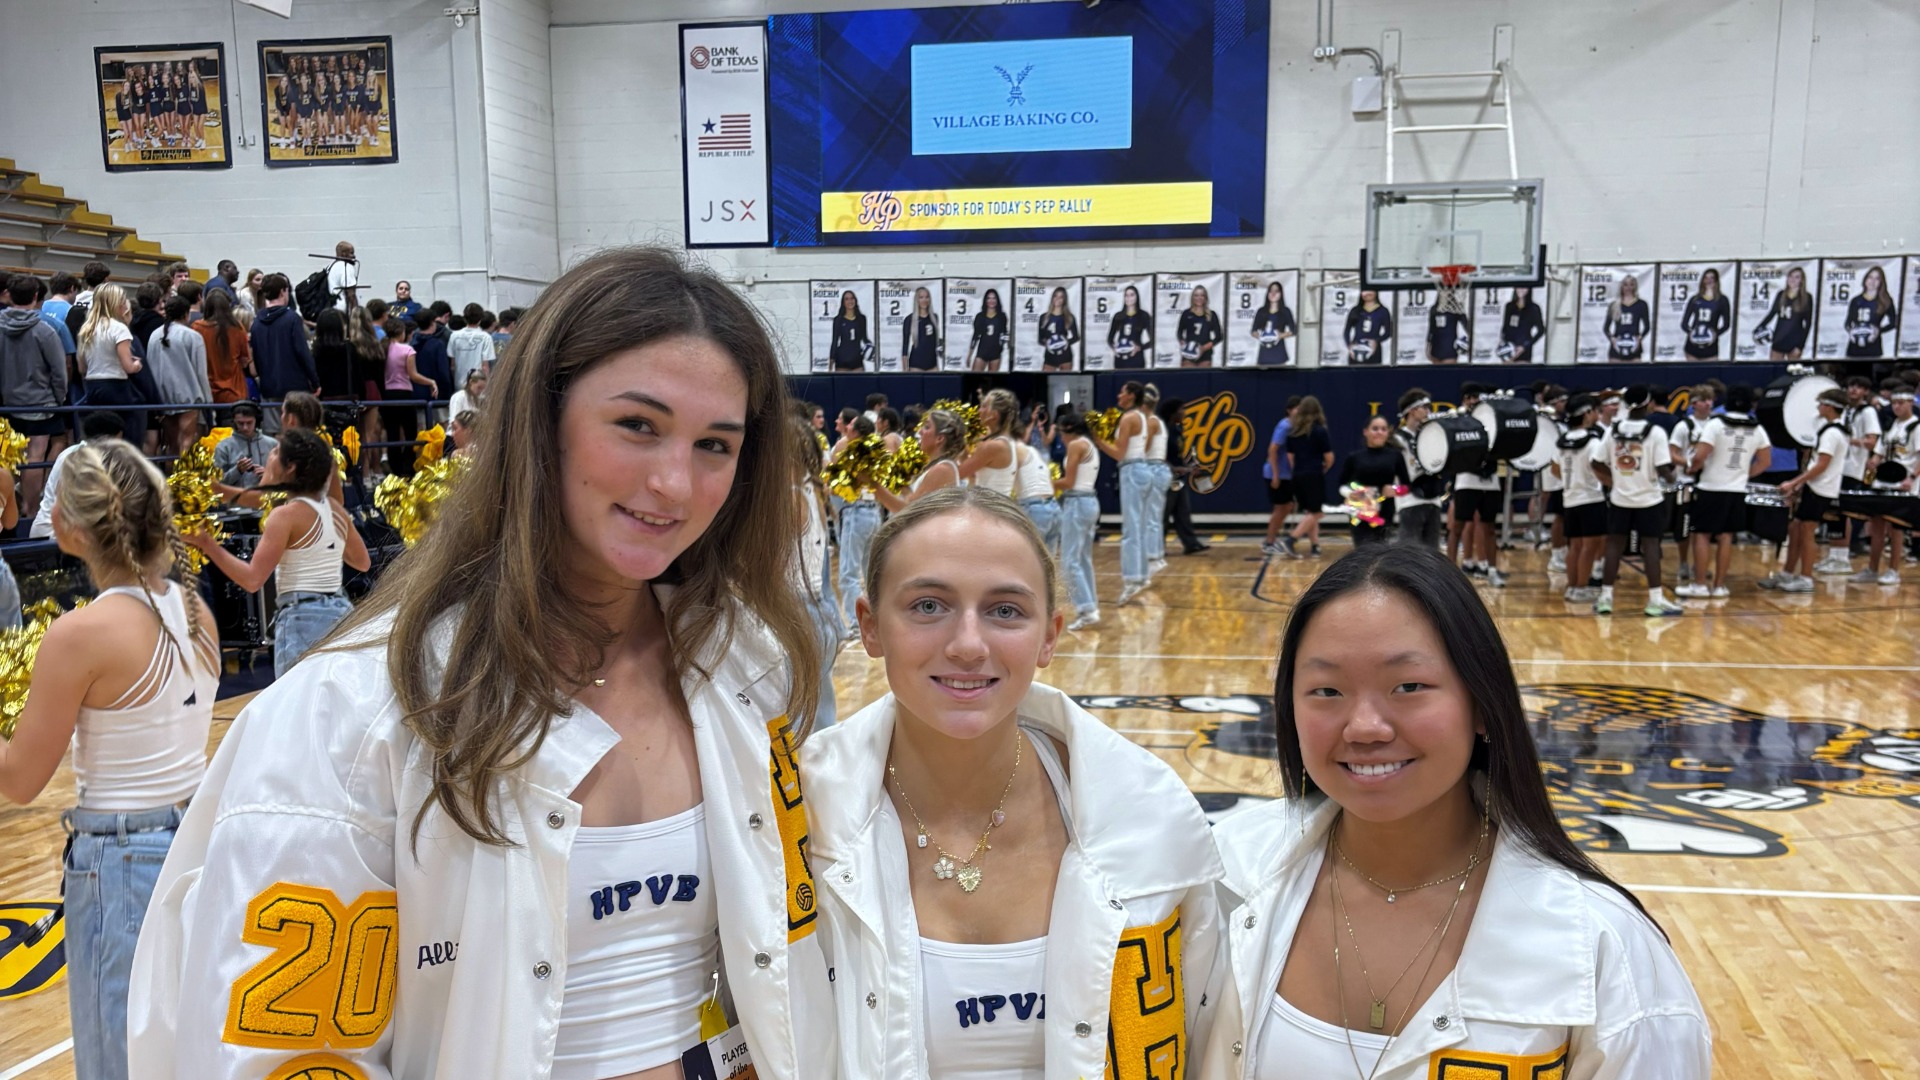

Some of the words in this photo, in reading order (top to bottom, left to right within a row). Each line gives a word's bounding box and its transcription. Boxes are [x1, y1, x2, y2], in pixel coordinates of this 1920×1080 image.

[711, 46, 739, 57] BANK
[711, 57, 724, 67] OF
[726, 56, 759, 66] TEXAS
[933, 114, 1001, 129] VILLAGE
[1005, 112, 1067, 127] BAKING
[1071, 111, 1099, 124] CO.
[701, 199, 756, 222] JSX
[909, 202, 960, 217] SPONSOR
[963, 201, 985, 216] FOR
[988, 200, 1031, 215] TODAY'S
[1035, 199, 1055, 213] PEP
[1059, 198, 1093, 213] RALLY
[1661, 272, 1700, 282] MURRAY
[1826, 270, 1856, 281] SMITH
[1335, 291, 1346, 307] 9
[1408, 289, 1425, 306] 10
[1485, 287, 1499, 305] 11
[1588, 285, 1607, 302] 12
[1669, 284, 1688, 302] 13
[1751, 282, 1769, 300] 14
[1830, 283, 1850, 302] 16
[823, 300, 830, 316] 1
[890, 300, 901, 316] 2
[956, 299, 967, 315] 3
[1025, 297, 1035, 313] 4
[1097, 297, 1107, 313] 6
[1169, 293, 1180, 309] 7
[1241, 293, 1251, 309] 8
[590, 873, 700, 921] HPVB
[232, 888, 398, 1042] 20
[721, 1042, 749, 1066] PLAYER
[730, 1068, 738, 1080] of
[737, 1062, 748, 1075] the
